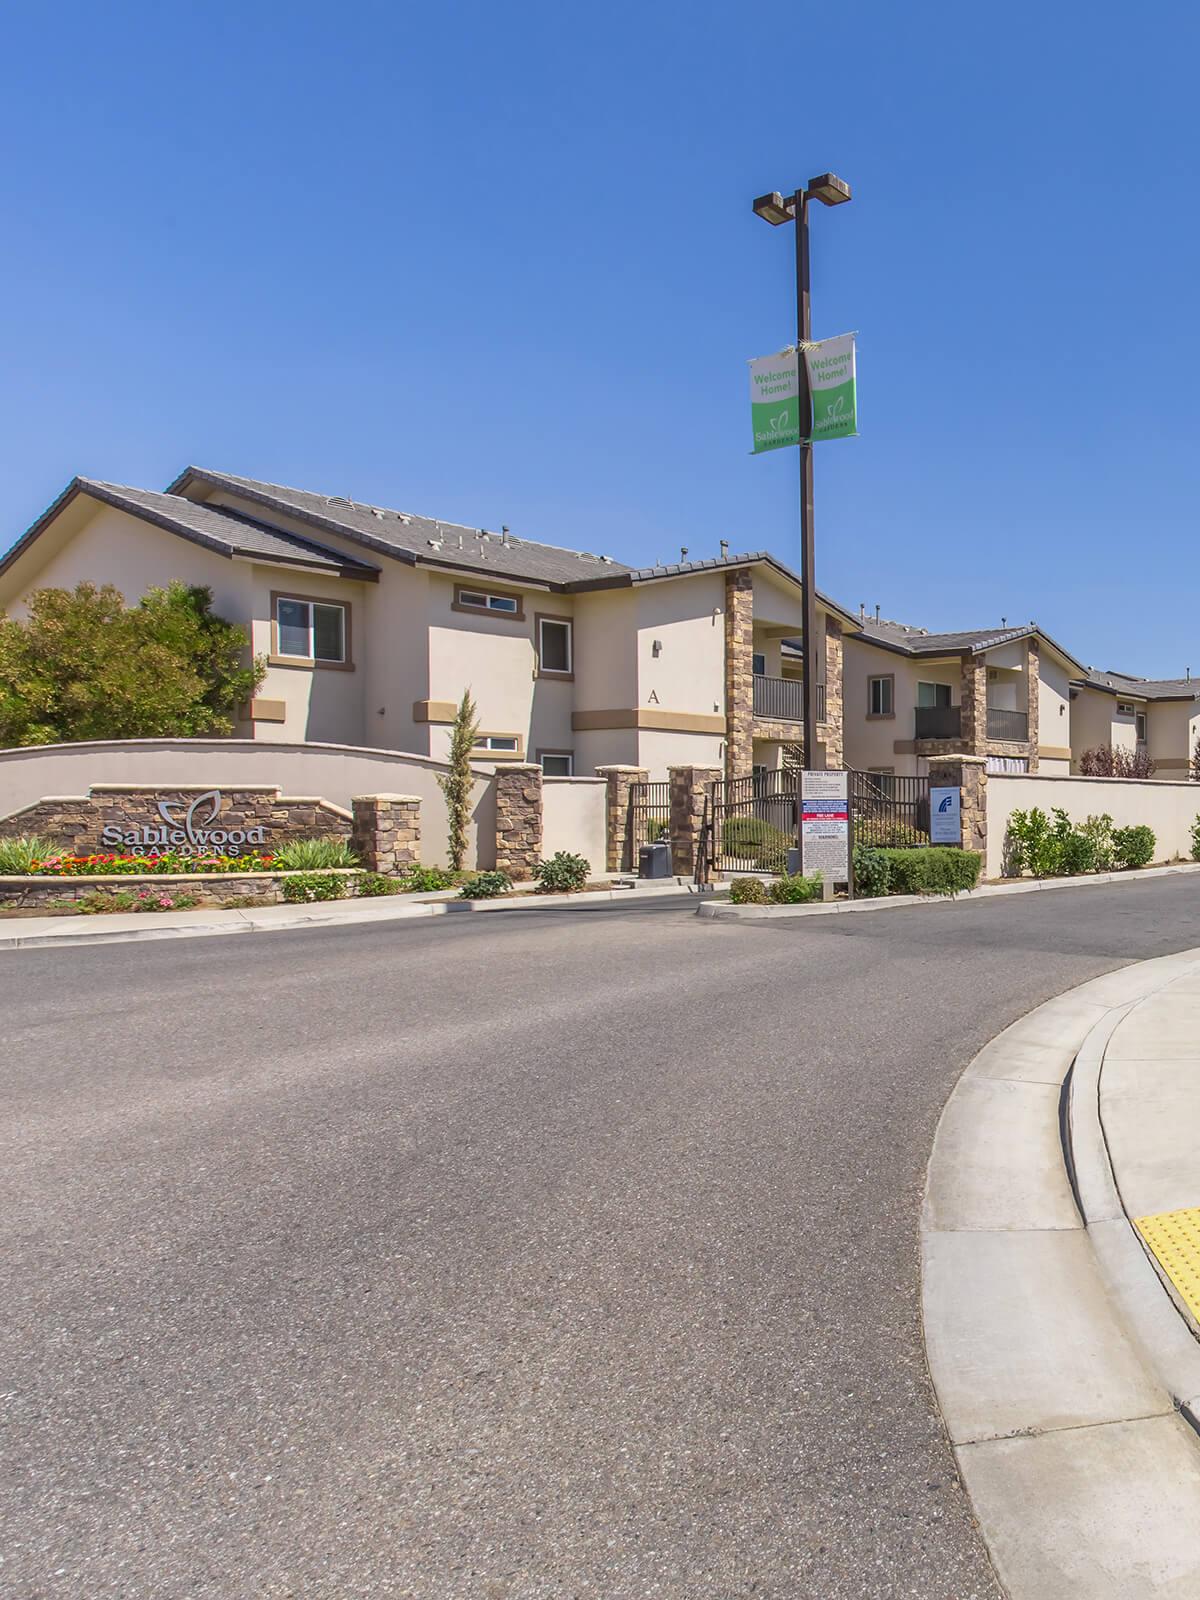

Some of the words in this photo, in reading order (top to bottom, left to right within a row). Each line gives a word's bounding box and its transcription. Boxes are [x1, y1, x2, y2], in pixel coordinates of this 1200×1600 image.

[810, 352, 851, 370] Welcome
[754, 369, 796, 385] Welcome
[818, 365, 847, 382] Home!
[761, 380, 791, 395] Home!
[648, 689, 660, 704] A
[102, 825, 266, 846] Sablewood
[131, 845, 240, 856] GARDENS
